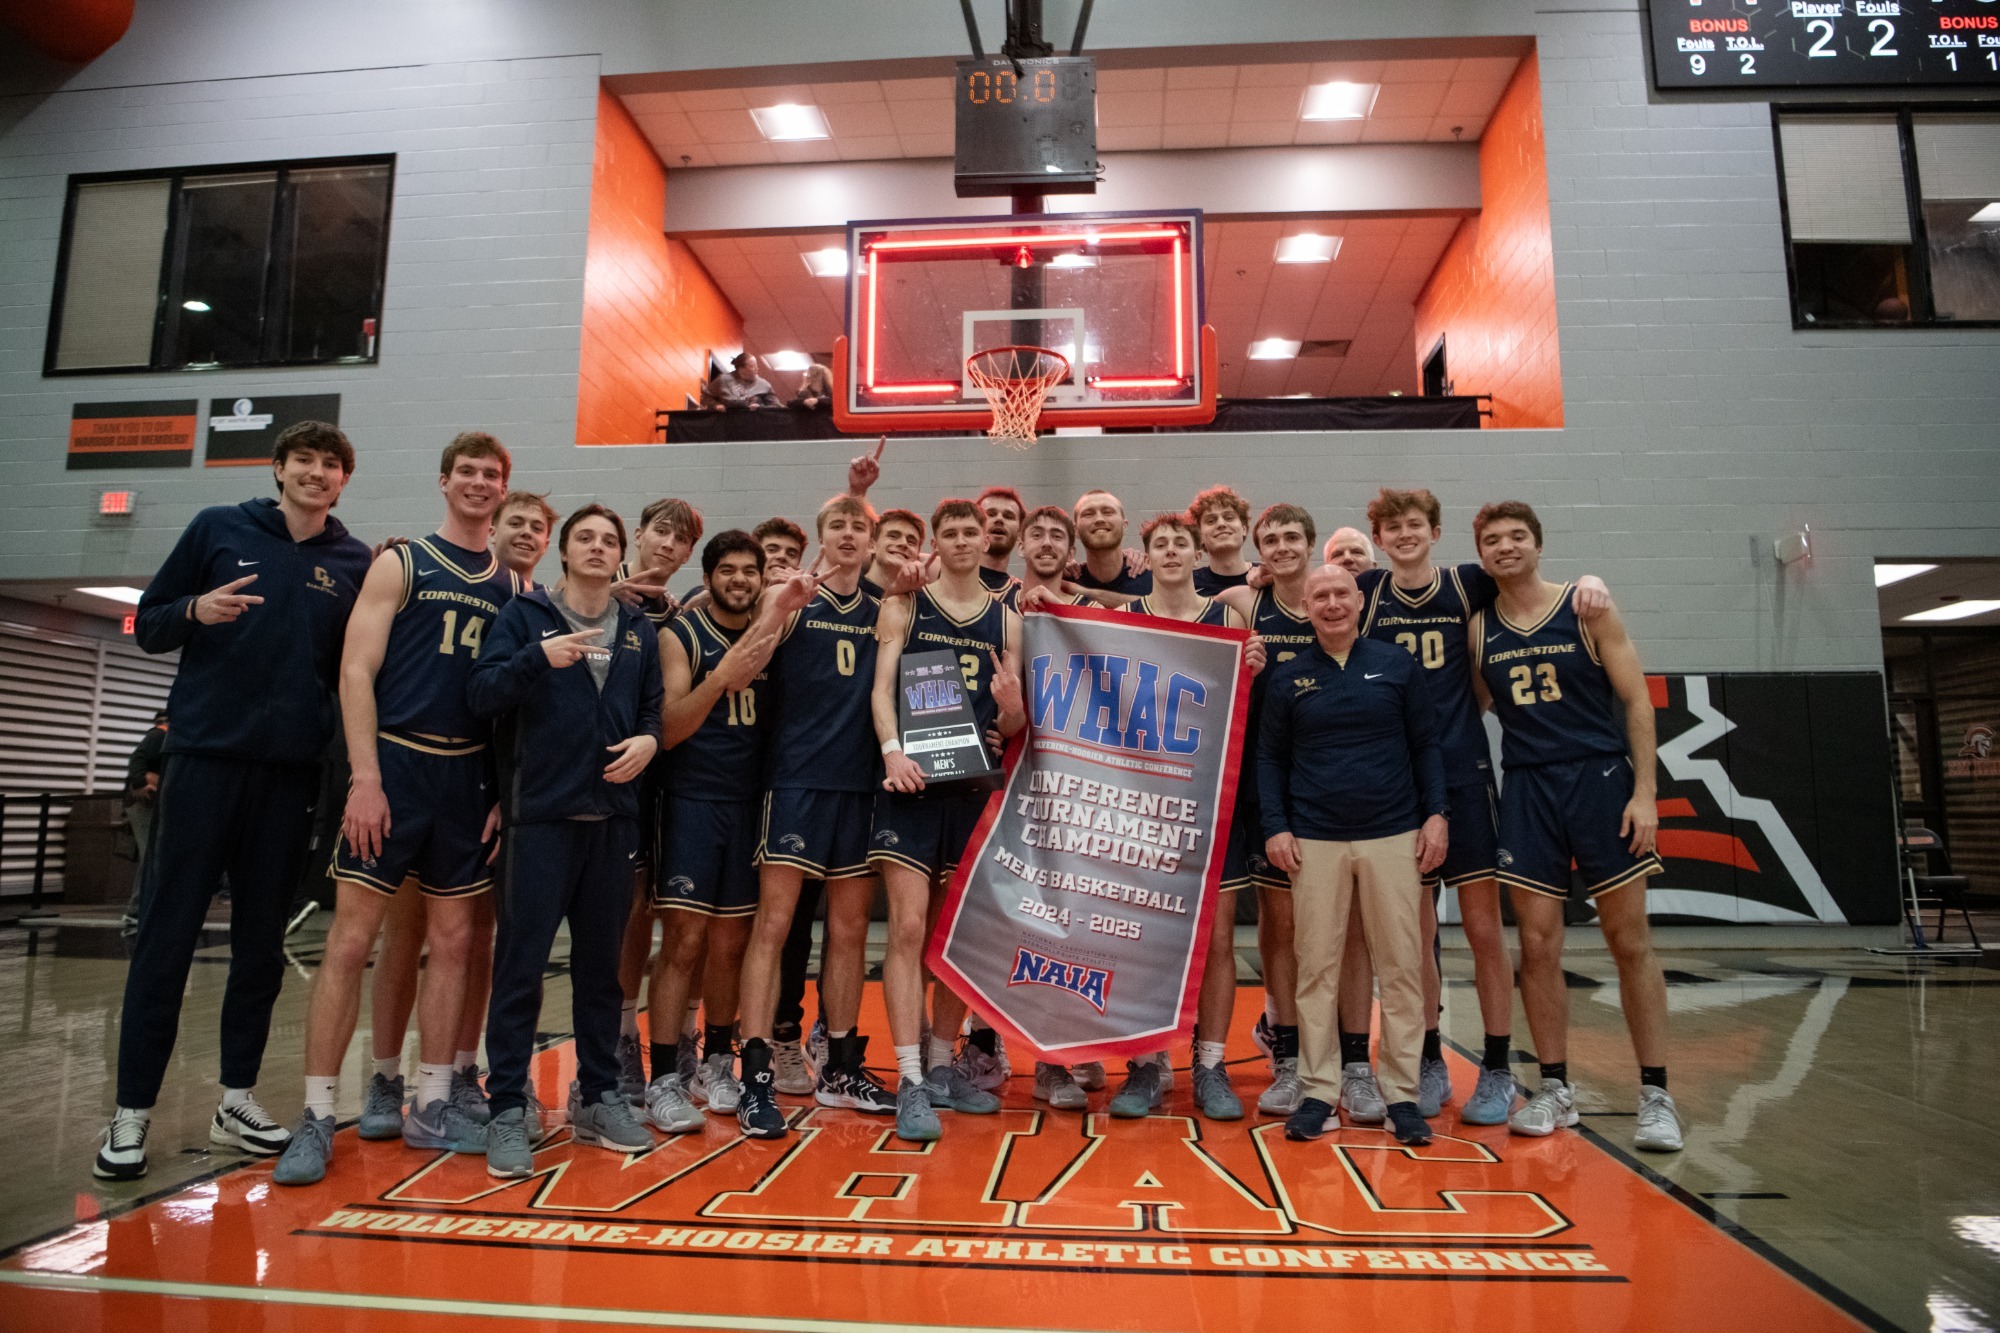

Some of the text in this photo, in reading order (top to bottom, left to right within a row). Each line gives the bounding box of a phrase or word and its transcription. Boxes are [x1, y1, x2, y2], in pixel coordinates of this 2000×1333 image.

[1791, 0, 1900, 16] Player Fouls
[1939, 16, 1999, 30] BONUS
[1689, 18, 1749, 33] BONUS
[1806, 18, 1898, 58] 2 2
[1928, 34, 1967, 46] T.O.L.
[1677, 36, 1765, 50] Fouls T.O.L.
[1689, 53, 1756, 76] 9 2
[1946, 51, 1957, 71] 1
[969, 70, 1055, 104] 00.0
[439, 609, 486, 660] 14
[1378, 616, 1463, 627] CORNERSTONE
[836, 639, 856, 677] 0
[1488, 643, 1577, 664] CORNERSTONE
[905, 679, 963, 710] WHAC
[1508, 662, 1563, 706] 23
[726, 687, 757, 726] 10
[1030, 652, 1208, 756] WHAC
[913, 737, 971, 752] TOURNAMENT CHAMPION
[933, 757, 956, 771] MEN'S
[1105, 755, 1143, 770] ATHLETIC
[1144, 762, 1193, 778] CONFERENCE
[1029, 770, 1199, 824] CONFERENCE
[1016, 793, 1203, 852] TOURNAMENT
[1020, 823, 1182, 875] CHAMPIONS
[1050, 869, 1188, 915] BASKETBALL
[1017, 896, 1071, 928] 2024
[1089, 913, 1142, 941] 2025
[1008, 946, 1109, 1013] NAIA
[317, 1209, 1610, 1273] WOLVERINE-HOOSIER ATHLETIC CONFERENCE
